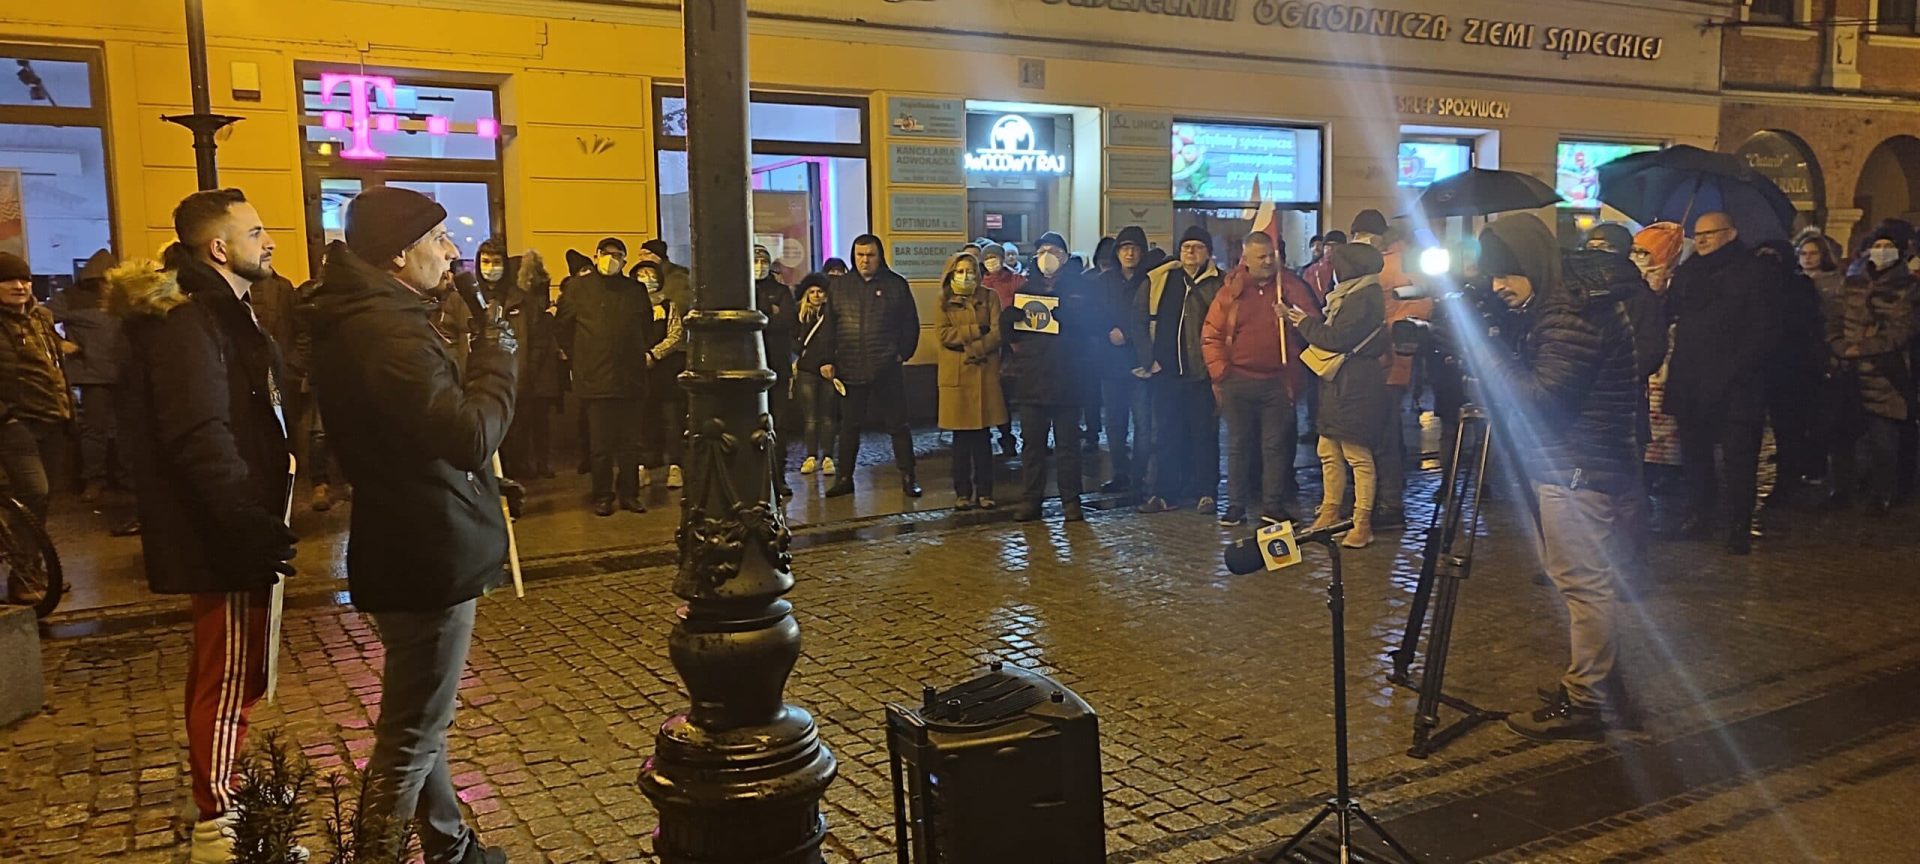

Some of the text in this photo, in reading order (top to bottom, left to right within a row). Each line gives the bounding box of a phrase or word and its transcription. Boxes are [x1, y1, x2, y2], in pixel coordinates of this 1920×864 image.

[1253, 0, 1448, 40] OGRODNICZA
[1463, 18, 1536, 49] ZIEMI
[1545, 26, 1663, 60] SĄDECKIEJ
[895, 217, 941, 228] OPTIMUM
[895, 246, 911, 256] BAR
